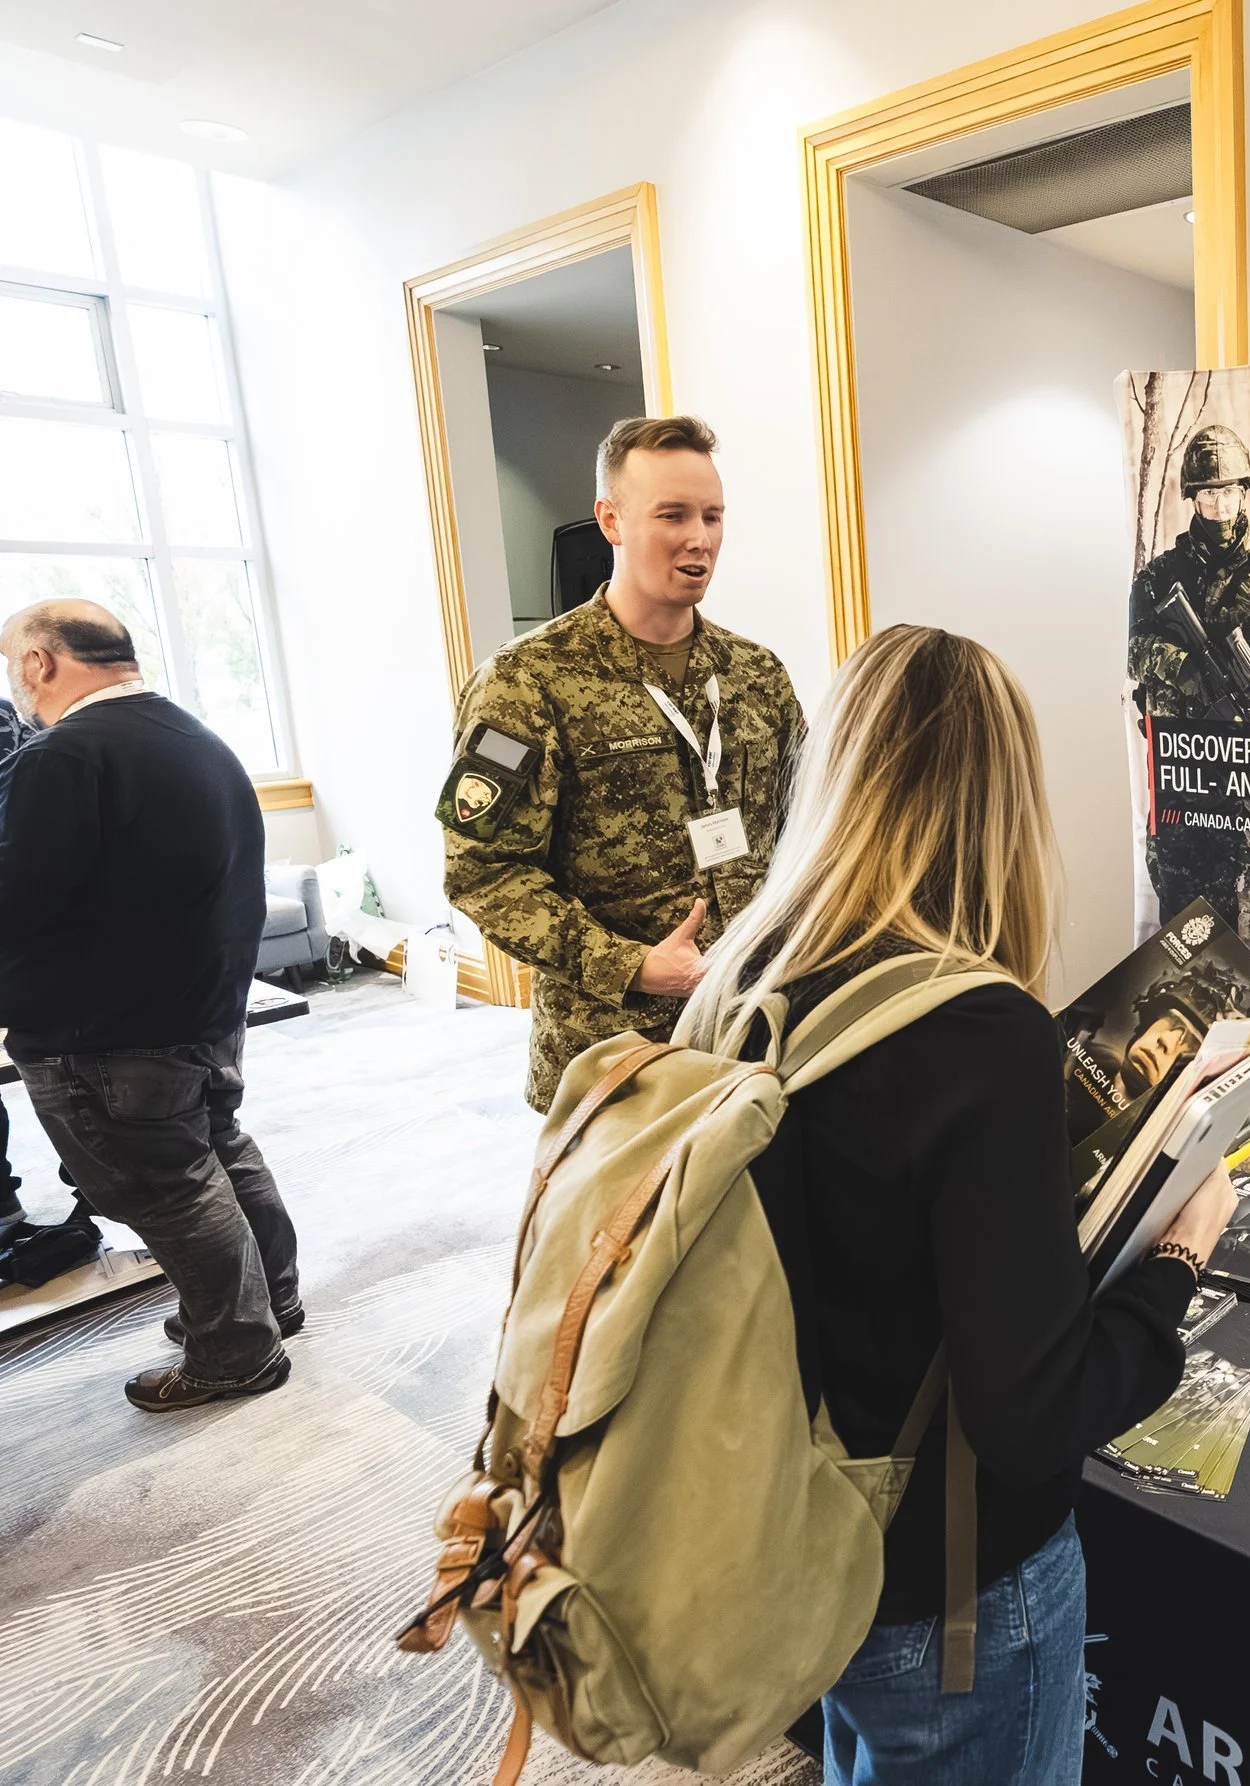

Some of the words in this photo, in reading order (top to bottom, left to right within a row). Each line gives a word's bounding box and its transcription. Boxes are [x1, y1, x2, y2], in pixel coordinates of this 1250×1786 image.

[608, 736, 662, 750] MORRISON
[1160, 765, 1217, 794] FULL-
[1166, 931, 1192, 960] FORCES
[1067, 1037, 1110, 1088] UNLEASH
[1074, 1068, 1106, 1107] CANADIAN
